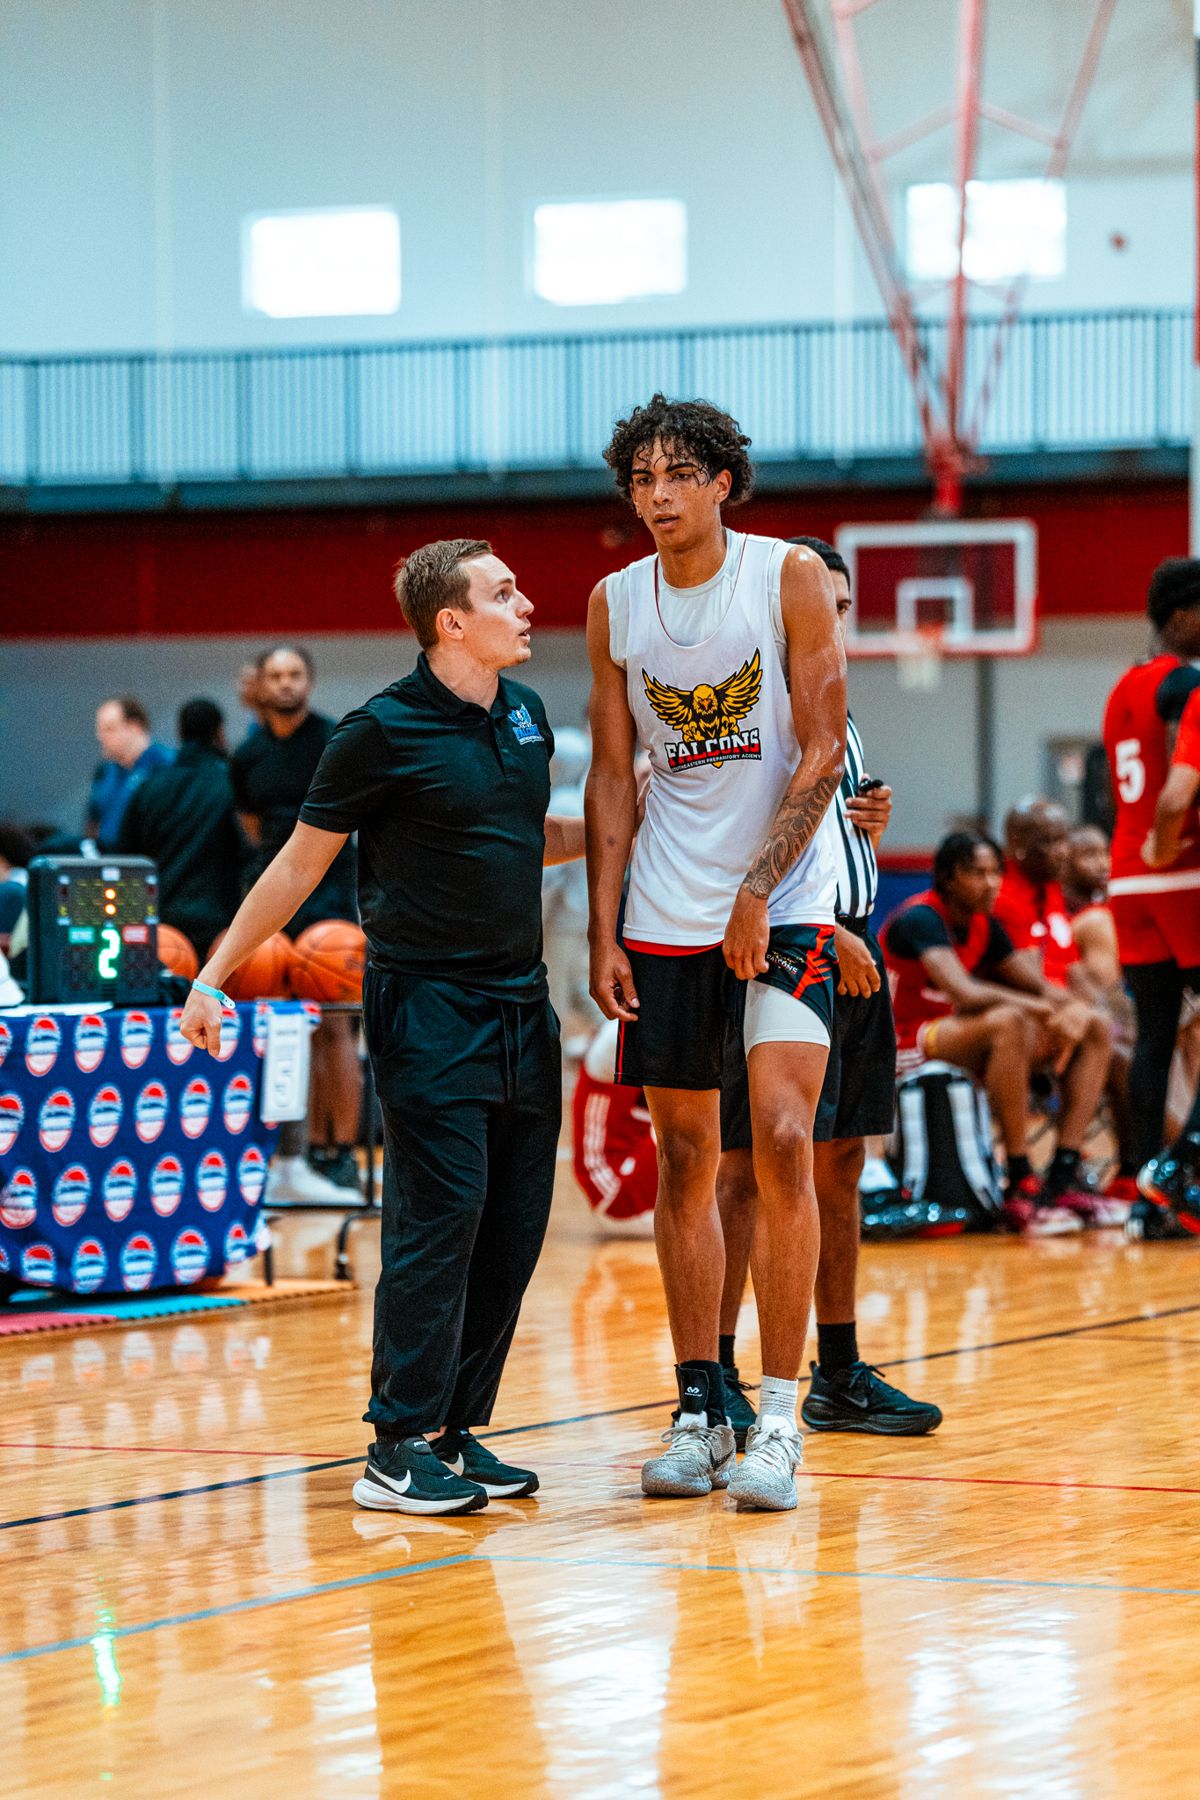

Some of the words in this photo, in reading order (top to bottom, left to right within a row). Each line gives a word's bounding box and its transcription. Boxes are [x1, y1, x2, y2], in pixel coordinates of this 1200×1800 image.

[665, 729, 760, 768] FALCONS
[1115, 737, 1146, 804] 5
[99, 929, 120, 979] 2
